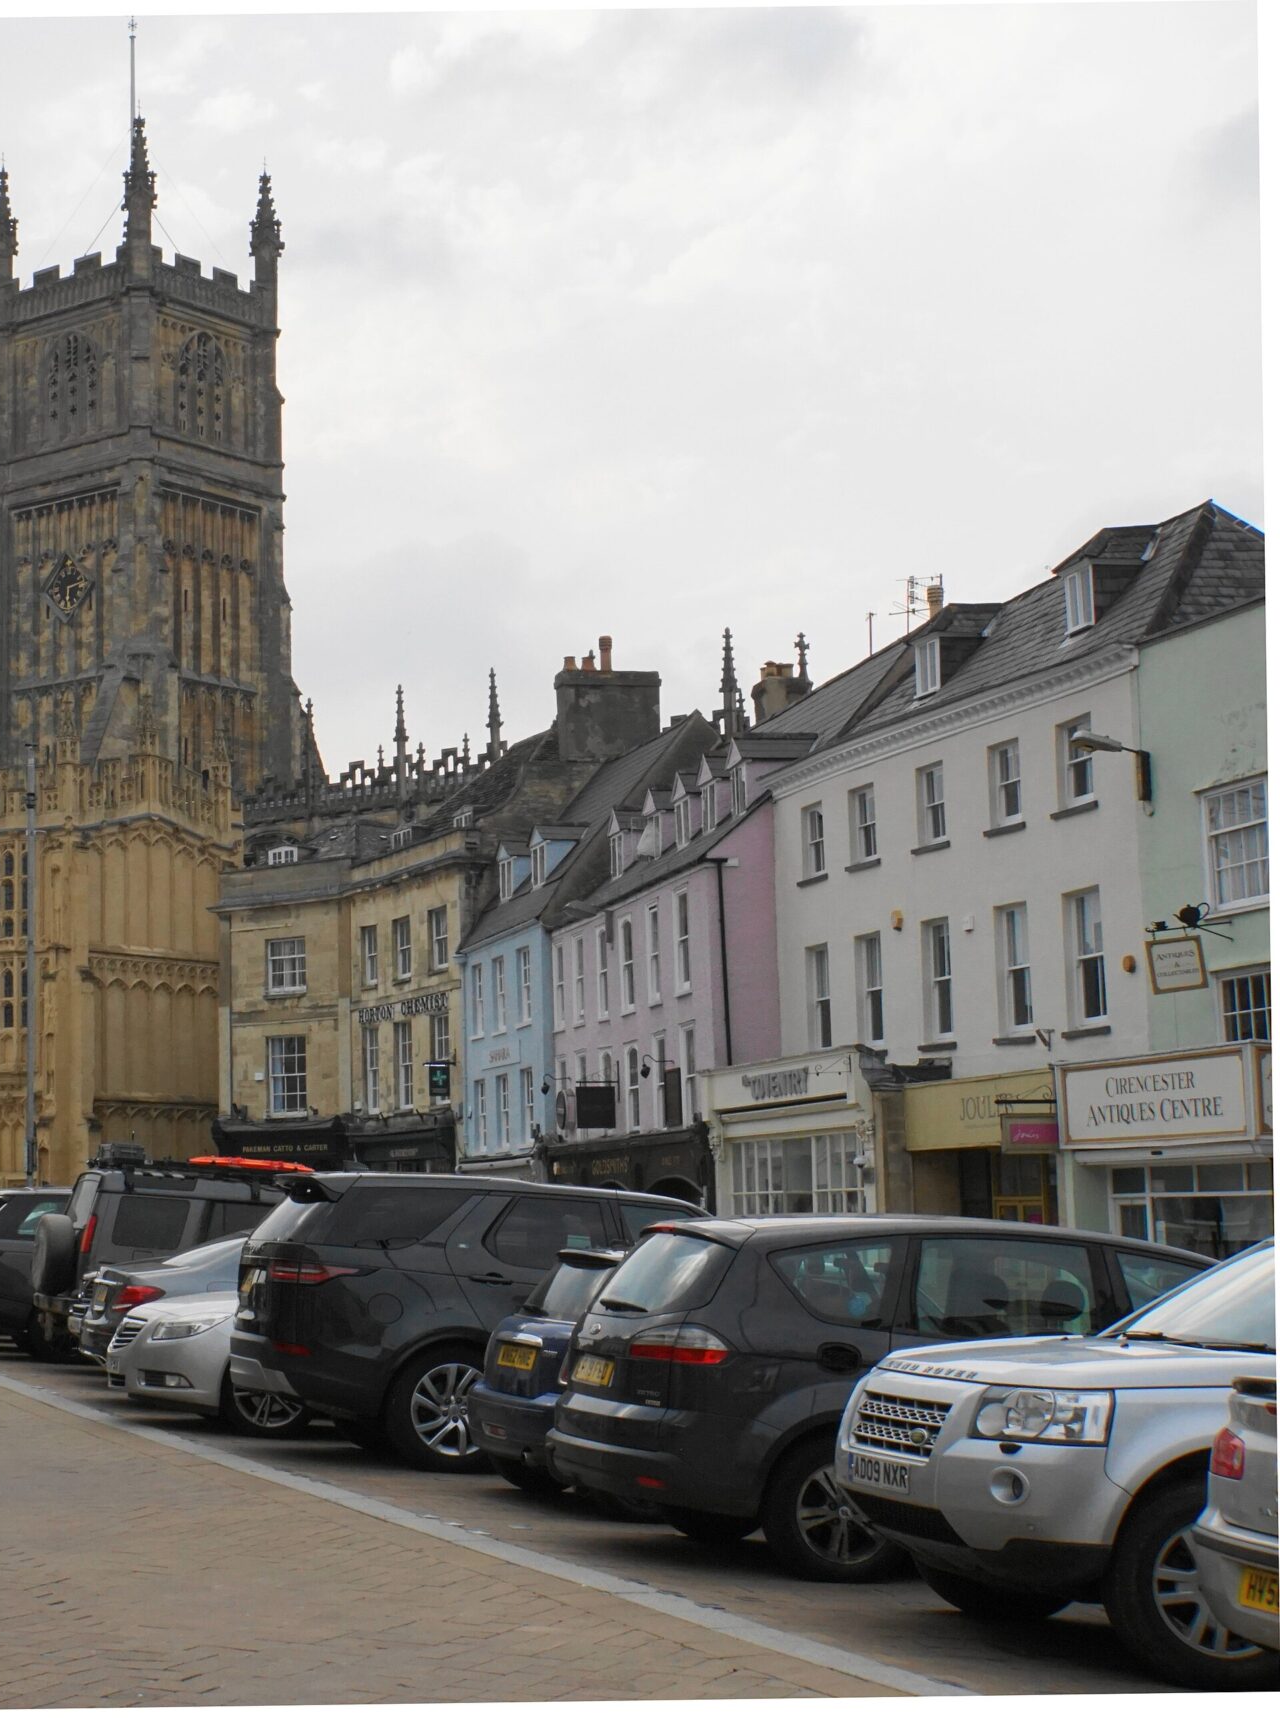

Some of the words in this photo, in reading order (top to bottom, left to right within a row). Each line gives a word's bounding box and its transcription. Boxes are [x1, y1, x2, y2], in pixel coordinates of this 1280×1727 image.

[1156, 950, 1195, 961] ANTIQUES
[358, 1004, 395, 1024] HORTON
[400, 993, 449, 1016] CHEMIST
[1105, 1071, 1195, 1098] CIRENCESTER
[1087, 1101, 1155, 1128] ANTIQUES
[1160, 1096, 1223, 1122] CENTRE
[242, 1144, 270, 1153] PAKEMAN
[273, 1144, 293, 1153] CATTO
[304, 1143, 328, 1151] CARTER
[854, 1454, 881, 1484] AD09
[883, 1463, 908, 1489] NXR
